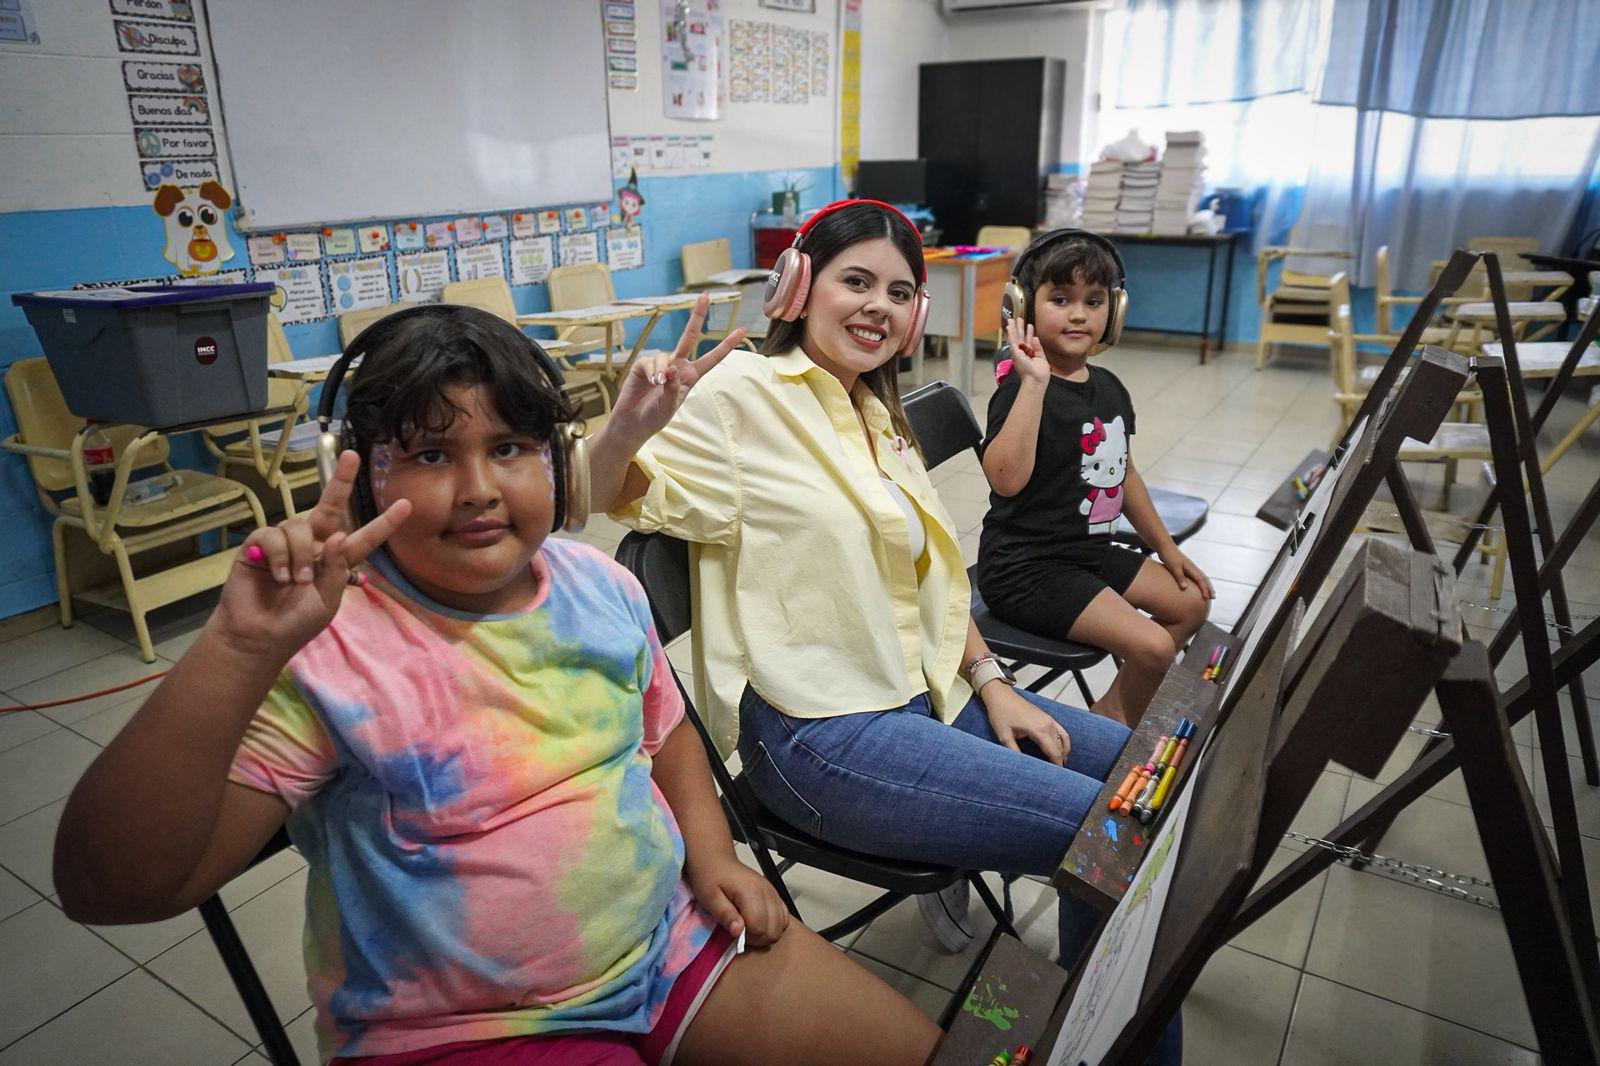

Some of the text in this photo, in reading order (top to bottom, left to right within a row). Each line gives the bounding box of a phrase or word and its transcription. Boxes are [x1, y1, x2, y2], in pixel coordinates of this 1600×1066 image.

[148, 33, 187, 48] Disculpa
[137, 69, 175, 80] Gracias
[138, 104, 172, 116] Buenos
[162, 138, 209, 148] Por favor
[175, 168, 212, 180] De nada
